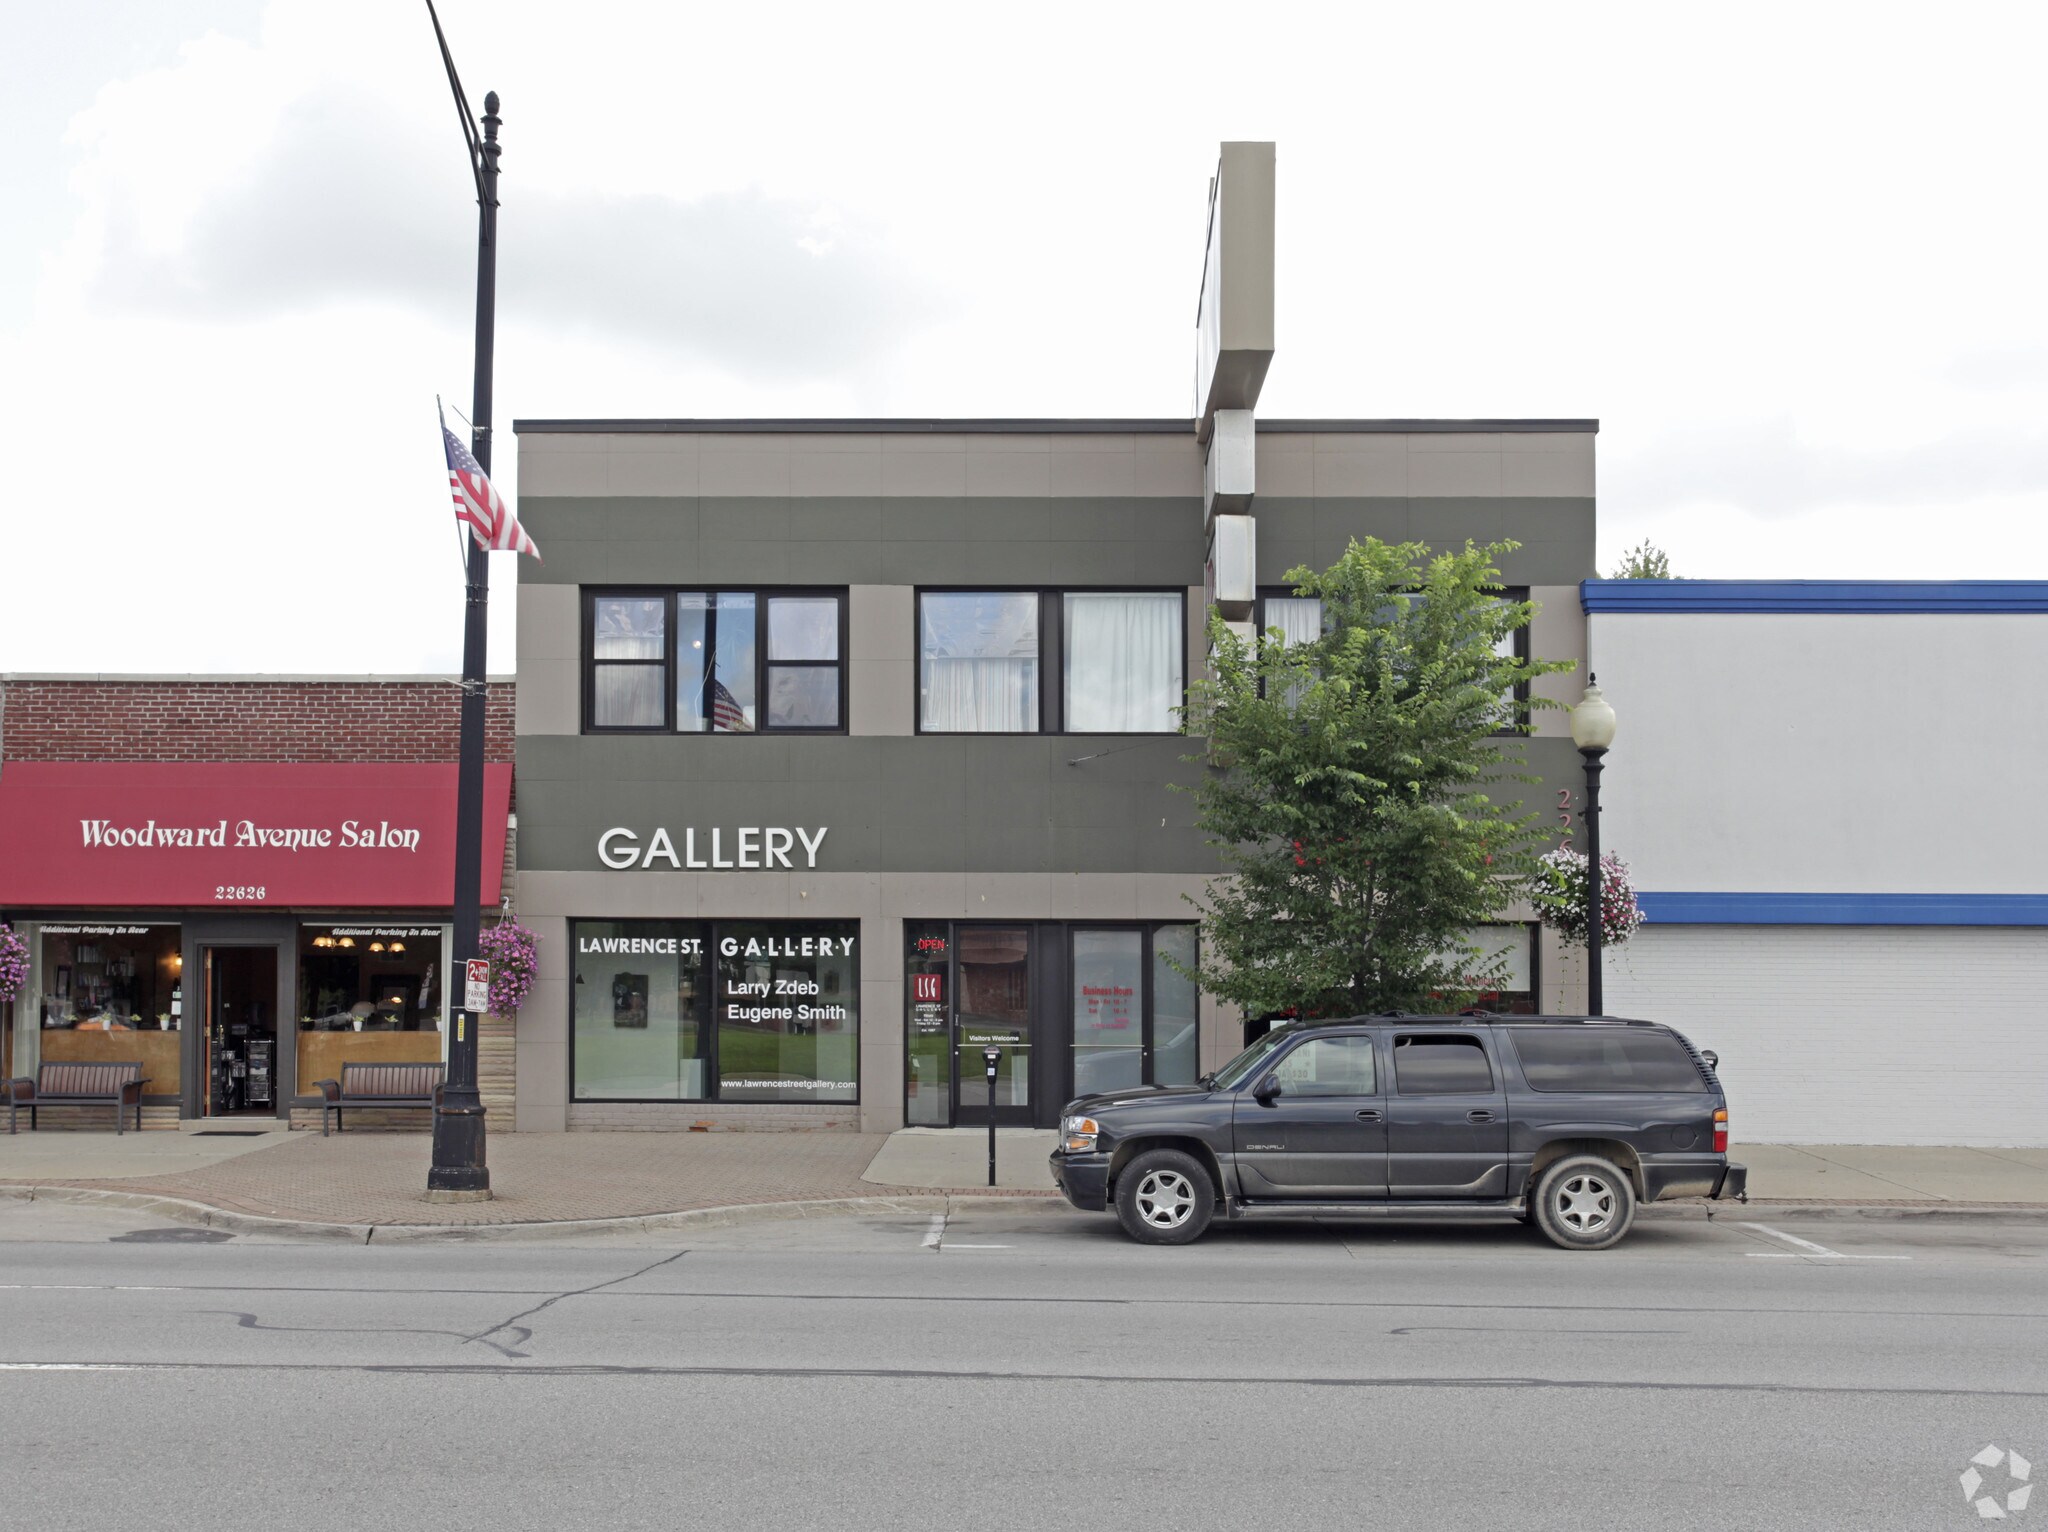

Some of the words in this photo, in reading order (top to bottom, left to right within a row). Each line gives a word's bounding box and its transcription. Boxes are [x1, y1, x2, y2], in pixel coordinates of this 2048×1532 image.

[80, 820, 227, 848] Woodward
[235, 820, 332, 853] Avenue
[339, 820, 420, 853] Salon
[597, 827, 829, 870] GALLERY
[214, 886, 266, 900] 22626
[39, 925, 81, 934] Additional
[82, 925, 115, 936] Parking
[127, 926, 149, 934] Rear
[332, 927, 374, 936] Additional
[374, 928, 408, 938] Parking
[420, 928, 441, 936] Rear
[580, 938, 676, 954] LAWRENCE
[680, 938, 704, 954] ST.
[918, 939, 945, 950] OPEN
[467, 990, 486, 998] PARKING
[727, 980, 771, 998] Larry
[774, 980, 819, 995] Zdeb
[918, 977, 936, 998] LSG
[1083, 986, 1111, 995] Business
[1113, 986, 1133, 995] Hours
[727, 1004, 793, 1023] Eugene
[797, 1004, 846, 1020] Smith
[721, 1079, 857, 1090] www.lawrencestreetgallery.com
